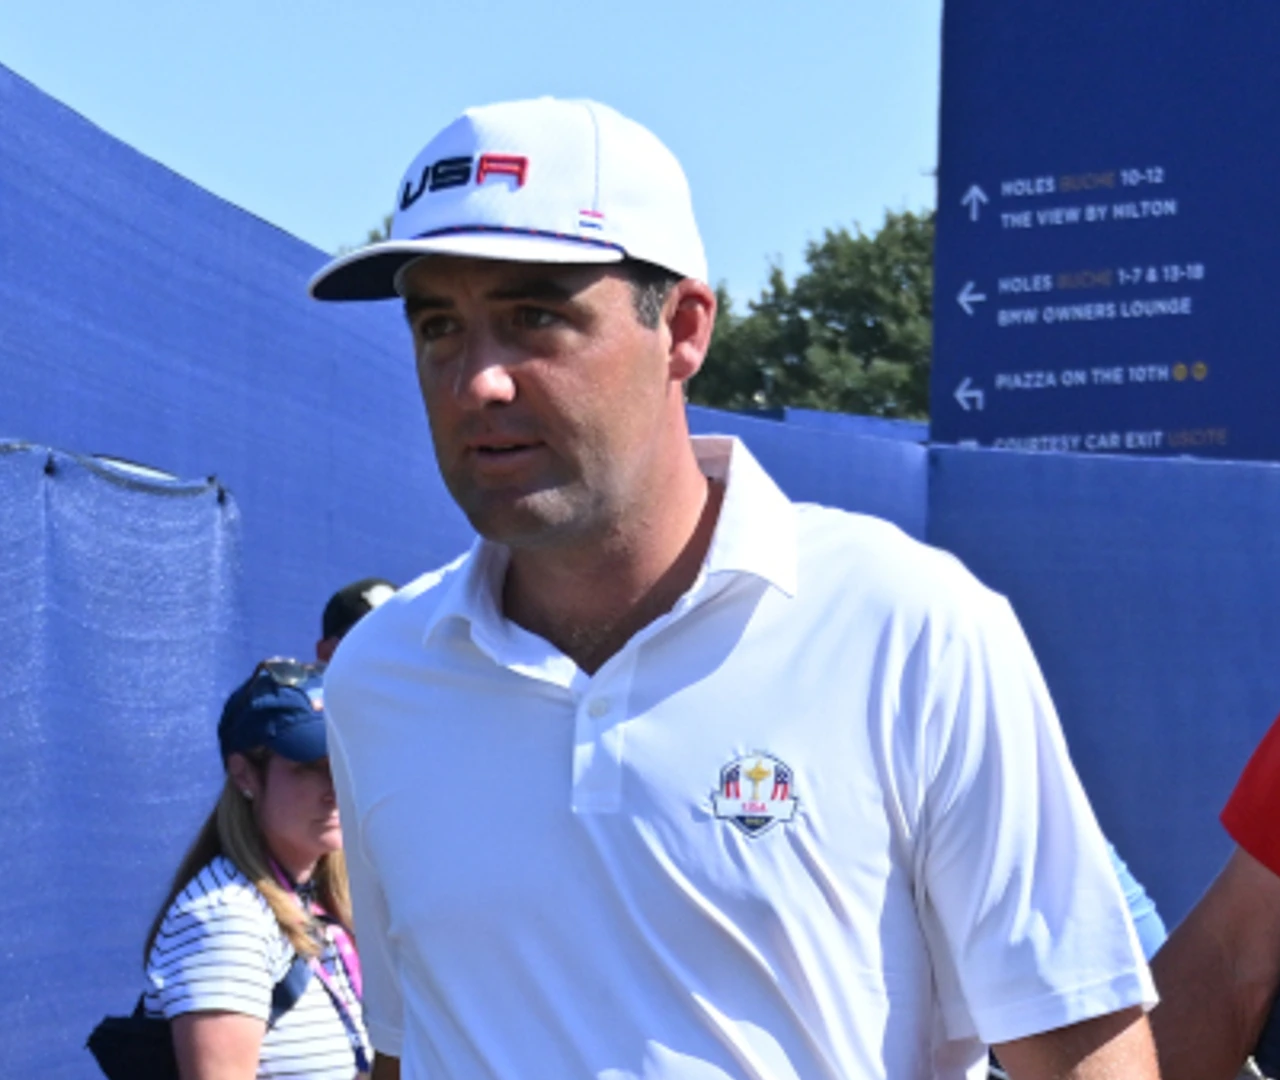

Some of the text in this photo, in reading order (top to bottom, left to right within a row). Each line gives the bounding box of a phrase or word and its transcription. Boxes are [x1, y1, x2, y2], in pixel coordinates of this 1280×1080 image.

[399, 153, 529, 211] USA
[1001, 176, 1055, 196] HOLES
[1121, 166, 1164, 186] 10-12
[1001, 199, 1177, 228] THE VIEW BY HILTON
[997, 274, 1053, 294] HOLES
[1118, 267, 1142, 285] 1-7
[997, 297, 1192, 327] BMW OWNERS LOUNGE
[994, 365, 1169, 390] PIAZZA ON THE 10TH
[993, 435, 1081, 453] COURTESY
[1084, 432, 1120, 450] CAR
[1125, 431, 1163, 449] EXIT
